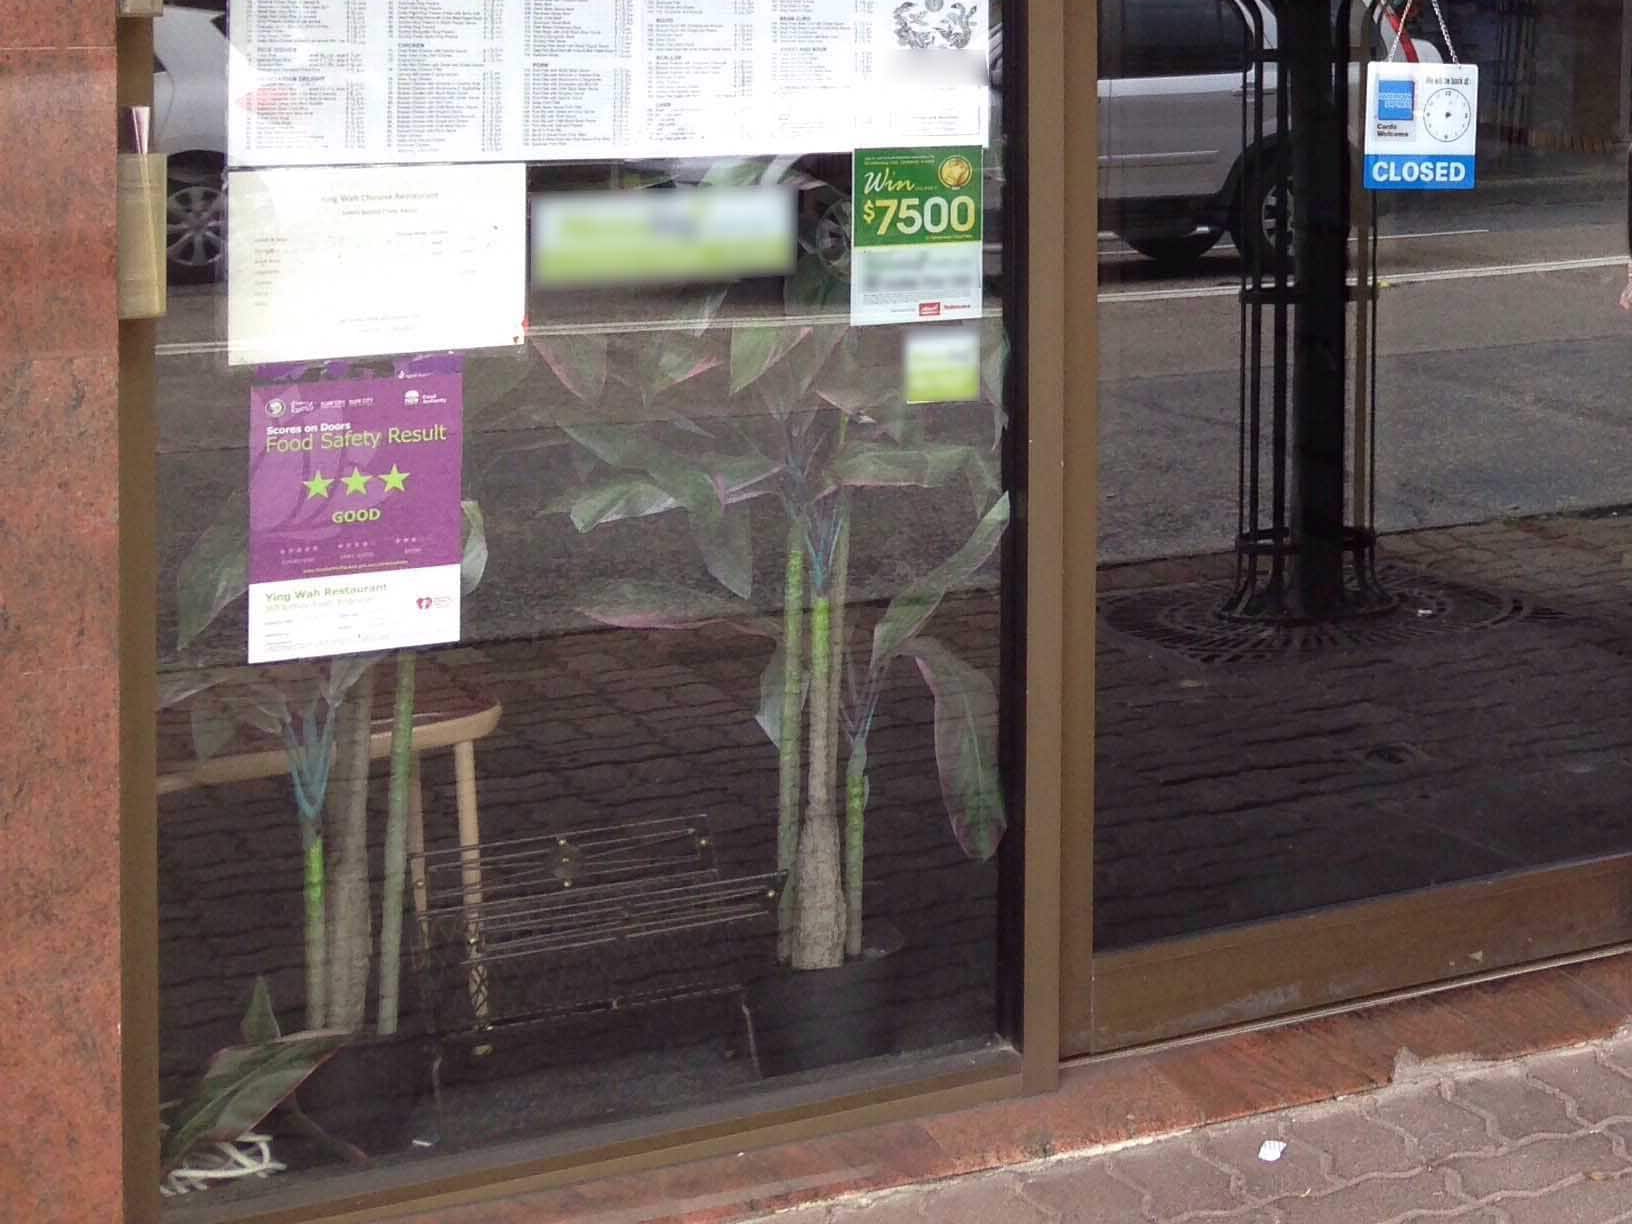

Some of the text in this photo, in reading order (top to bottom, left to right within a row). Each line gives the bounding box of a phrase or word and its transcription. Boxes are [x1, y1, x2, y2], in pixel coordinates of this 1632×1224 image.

[863, 167, 915, 195] Win
[1372, 161, 1466, 182] CLOSED
[863, 195, 976, 236] $7500
[266, 421, 351, 435] Scores on Doors
[266, 424, 448, 453] Food Safety Result
[332, 508, 381, 524] GOOD
